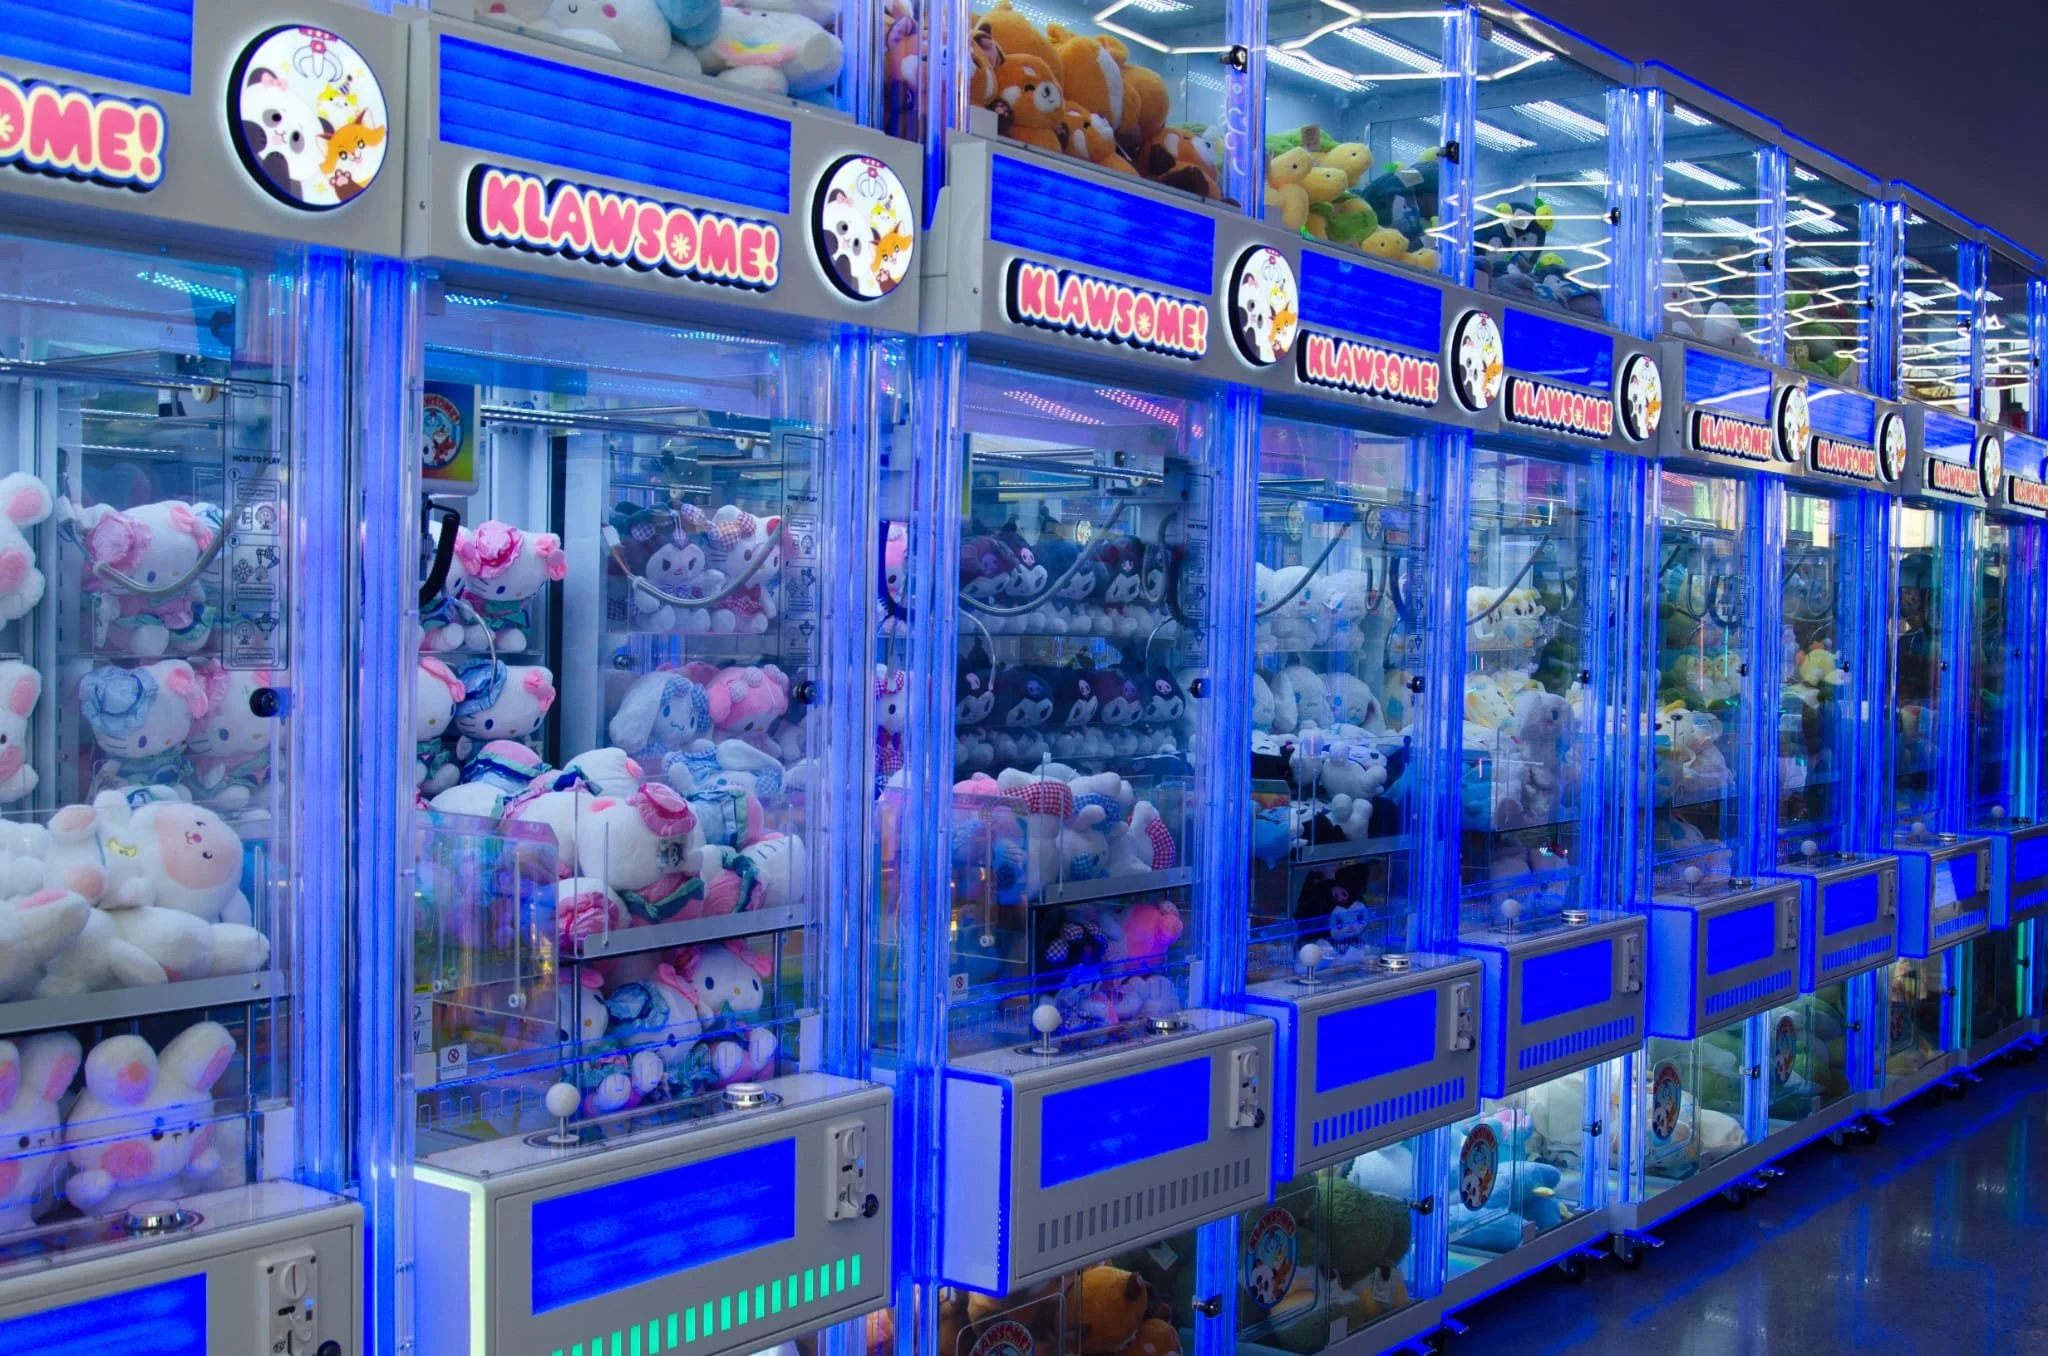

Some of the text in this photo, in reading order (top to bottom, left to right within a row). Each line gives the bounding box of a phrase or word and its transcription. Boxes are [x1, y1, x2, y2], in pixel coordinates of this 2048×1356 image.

[481, 169, 779, 287] KLAWSOME!
[1017, 262, 1209, 356] KLAWSOME!
[1305, 333, 1439, 405] KLAWSOME!
[1513, 380, 1613, 435] KLAWSOME!
[1700, 414, 1773, 459] KLAWSOME!
[232, 454, 280, 465] HOW TO PLAY
